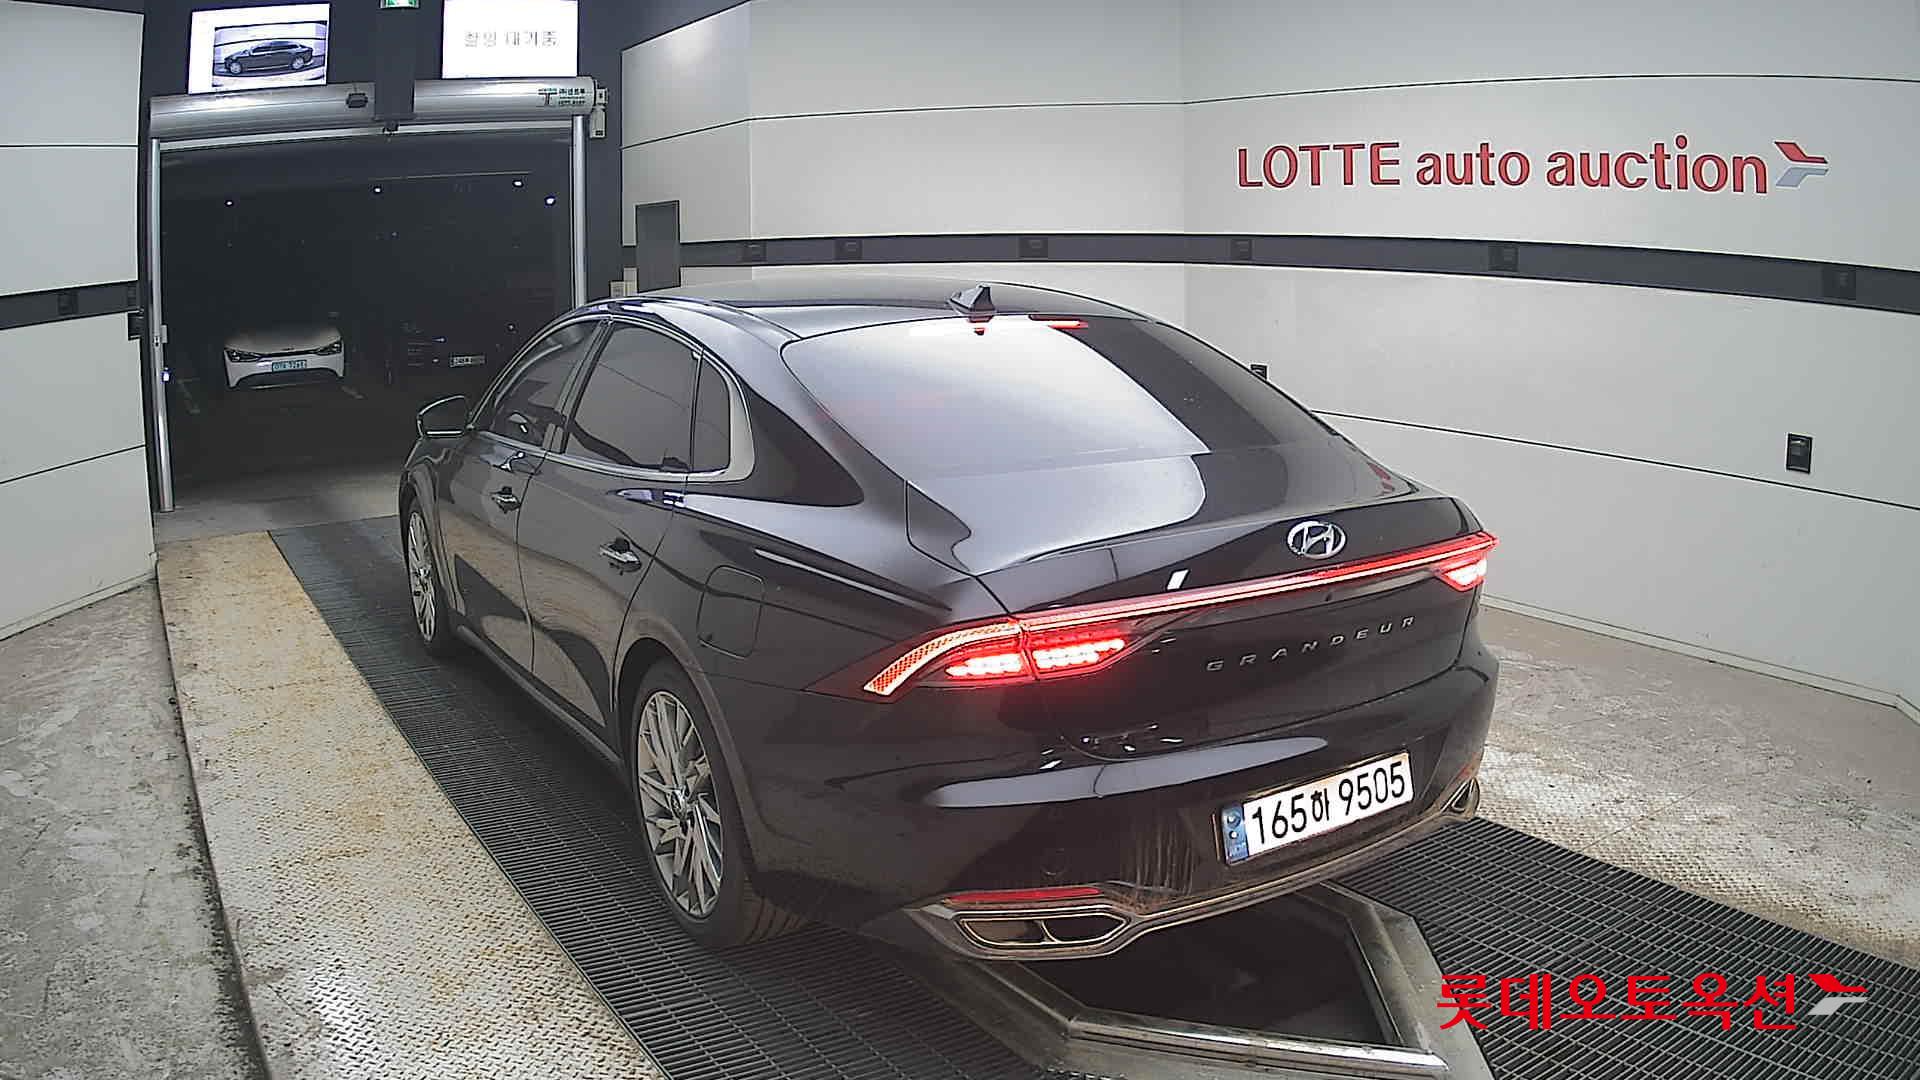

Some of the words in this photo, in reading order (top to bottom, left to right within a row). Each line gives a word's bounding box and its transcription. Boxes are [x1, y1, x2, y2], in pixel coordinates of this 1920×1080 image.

[1237, 142, 1400, 188] LOTTE
[1416, 142, 1530, 188] auto
[1546, 134, 1767, 193] auction
[1206, 616, 1415, 671] GRANDEUR
[1252, 788, 1330, 844] 165하
[1338, 761, 1405, 816] 9505
